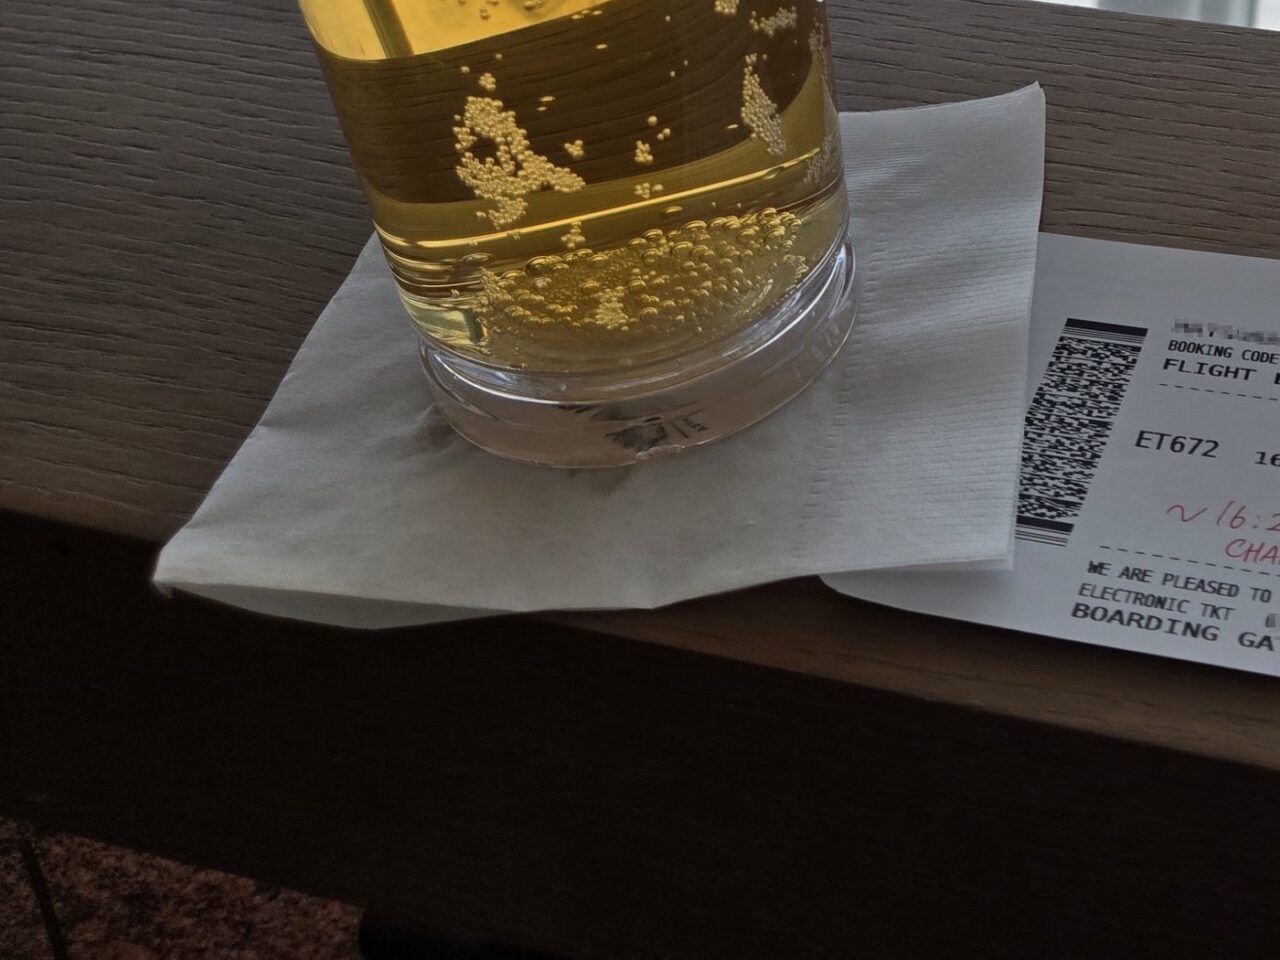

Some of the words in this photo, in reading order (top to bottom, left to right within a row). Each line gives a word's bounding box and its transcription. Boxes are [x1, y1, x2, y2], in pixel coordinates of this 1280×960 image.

[1167, 340, 1233, 359] BOOKING
[1241, 349, 1280, 365] CODE
[1162, 358, 1257, 381] FLIGHT
[1134, 430, 1220, 459] ET672
[1087, 560, 1110, 577] WE
[1118, 566, 1154, 584] ARE
[1162, 573, 1240, 599] PLEASED
[1250, 587, 1272, 604] TO
[1078, 583, 1189, 614] ELECTRONIC
[1200, 601, 1236, 621] TKT
[1070, 602, 1222, 643] BOARDING
